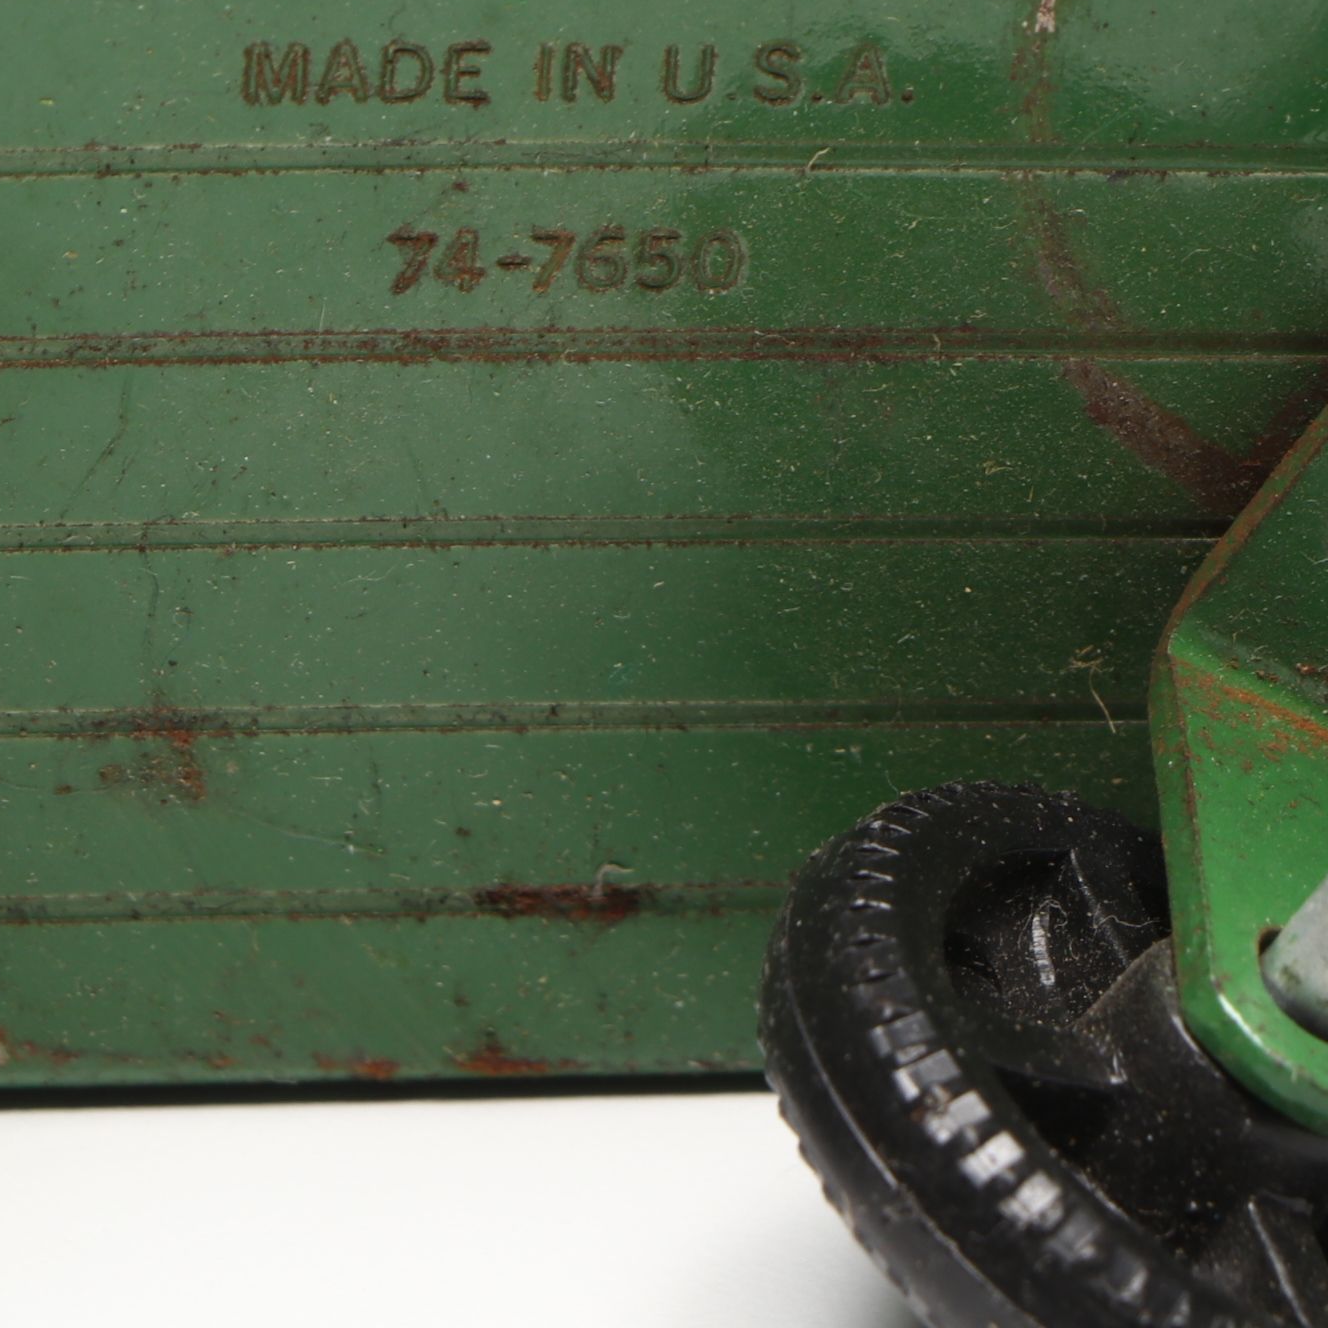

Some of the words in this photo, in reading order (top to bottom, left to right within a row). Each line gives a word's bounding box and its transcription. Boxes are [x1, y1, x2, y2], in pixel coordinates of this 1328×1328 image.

[240, 38, 492, 108] MADE
[534, 40, 623, 104] IN
[387, 225, 746, 295] 74-7650
